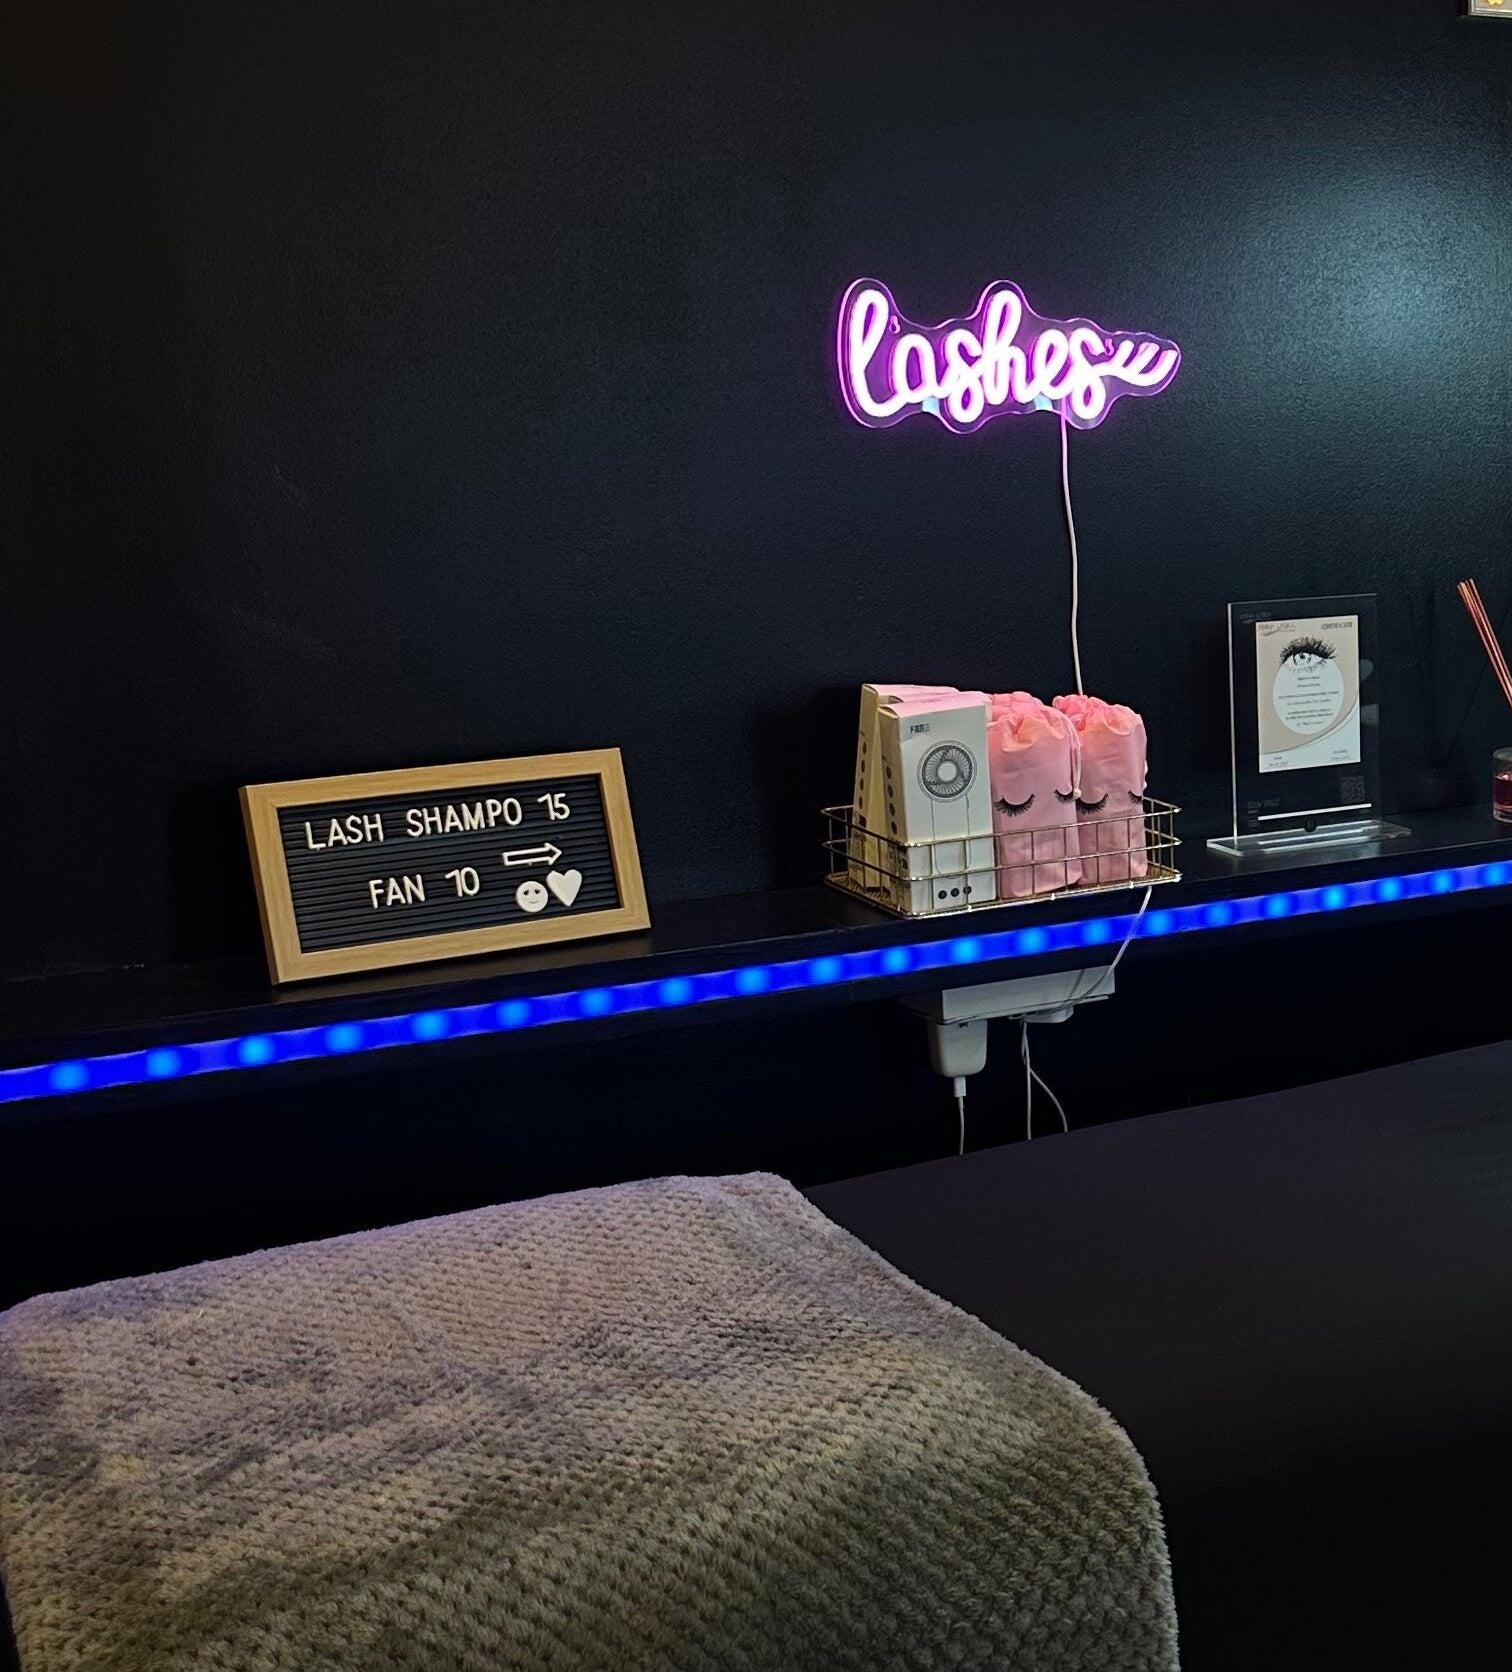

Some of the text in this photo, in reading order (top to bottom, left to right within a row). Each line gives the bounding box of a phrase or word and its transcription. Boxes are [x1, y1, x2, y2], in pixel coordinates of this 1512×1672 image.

[849, 289, 1106, 424] lashes
[304, 792, 571, 851] LASH SHAMPO 15
[368, 866, 480, 909] FAN 10
